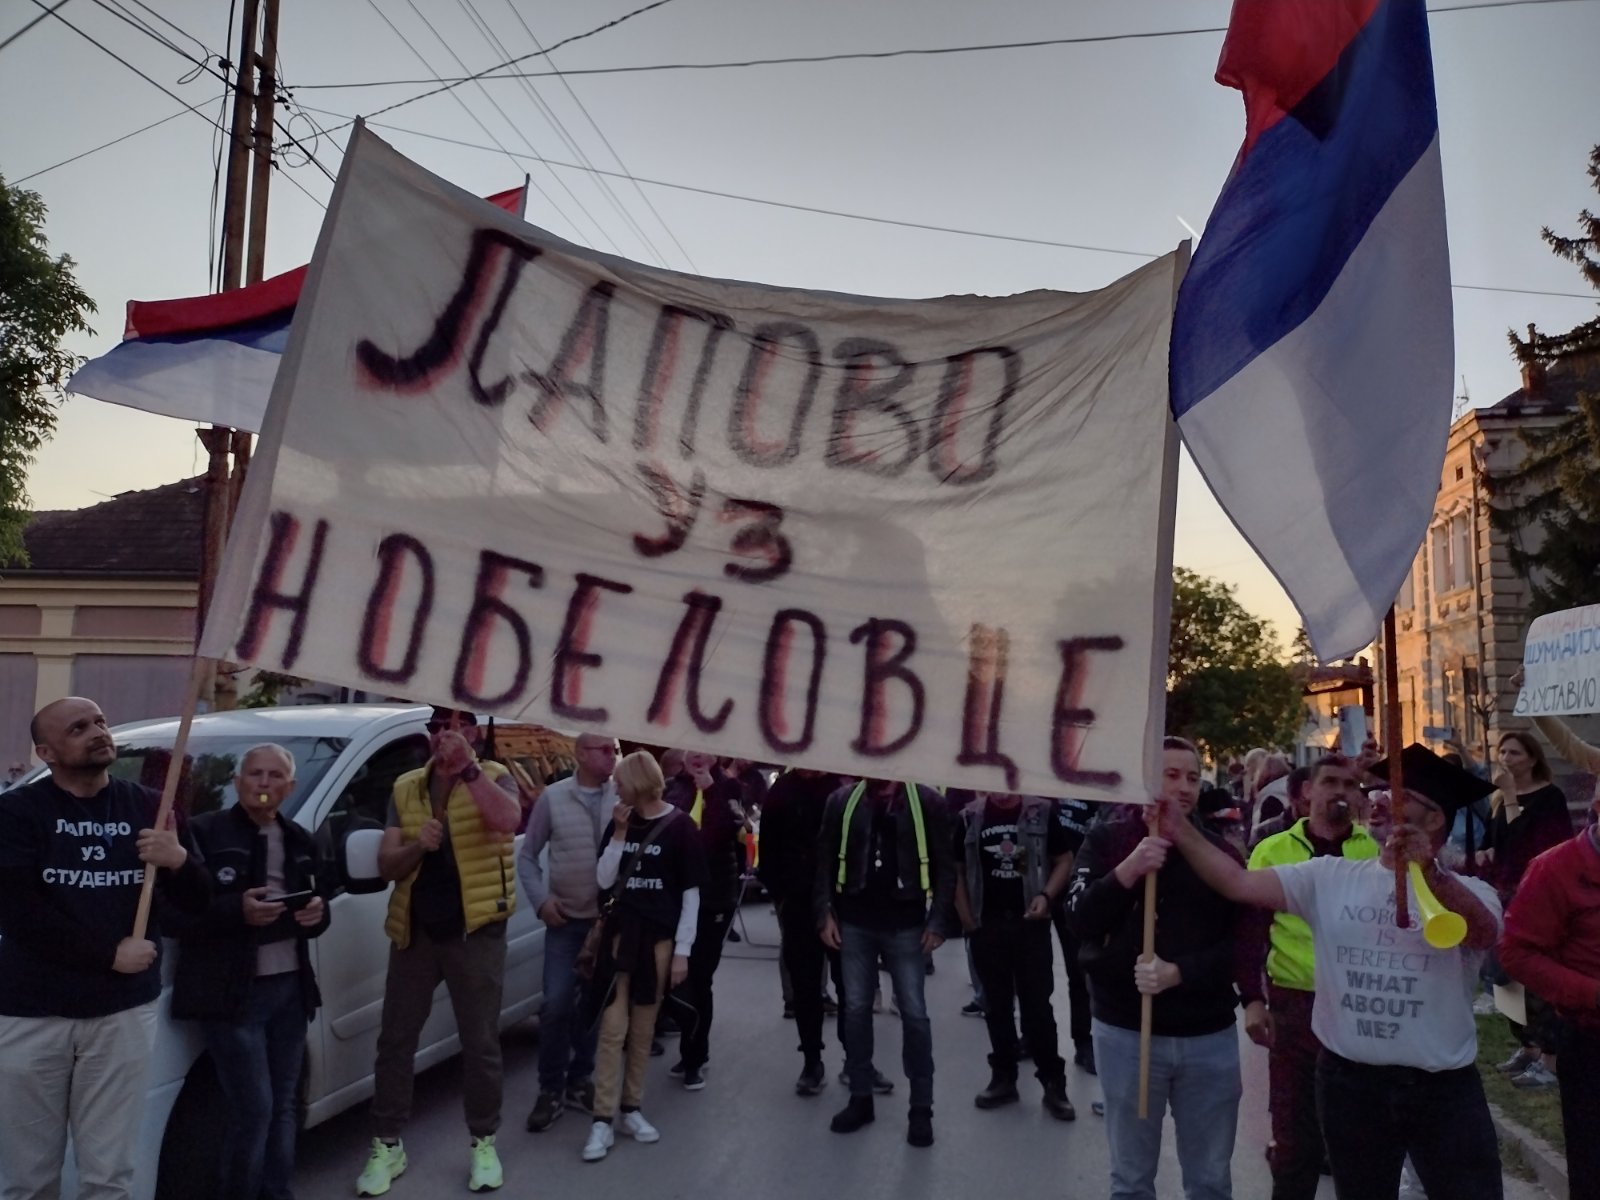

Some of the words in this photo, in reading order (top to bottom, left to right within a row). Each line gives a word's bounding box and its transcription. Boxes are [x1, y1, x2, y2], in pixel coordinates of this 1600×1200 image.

[356, 228, 1021, 487] ЛАПОВО
[633, 463, 795, 583] УЗ
[235, 508, 1125, 794] НОБЕЛОВЦЕ
[55, 818, 131, 836] ЛАПОВО
[81, 845, 106, 861] УЗ
[623, 841, 662, 856] АПВО
[42, 867, 145, 888] СТУДЕНТЕ
[1375, 928, 1396, 947] IS
[1336, 945, 1431, 972] PERFECT
[1345, 969, 1419, 995] WHAT
[1340, 993, 1424, 1018] ABOUT
[1356, 1018, 1400, 1039] ME?
